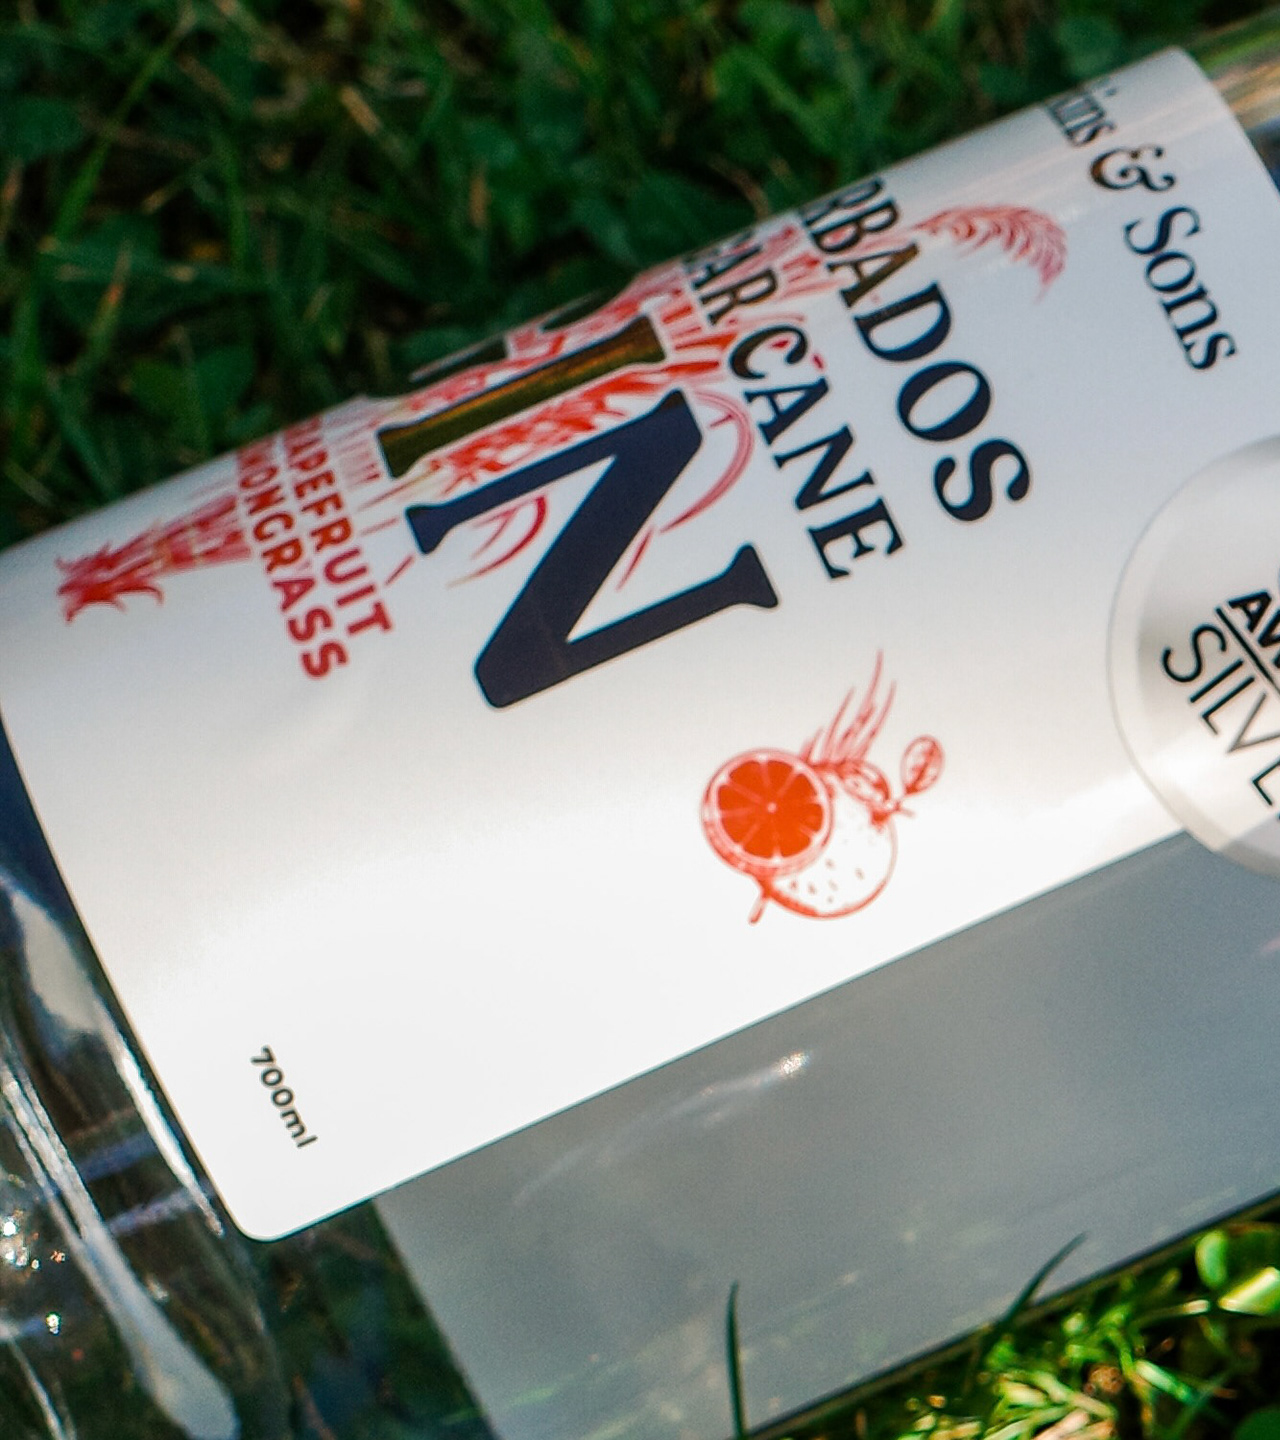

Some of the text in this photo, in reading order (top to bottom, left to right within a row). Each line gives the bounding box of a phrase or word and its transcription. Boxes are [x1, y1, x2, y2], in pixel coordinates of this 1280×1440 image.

[1091, 146, 1175, 191] &
[1124, 206, 1237, 370] Sons
[729, 325, 904, 580] CANE
[251, 1046, 318, 1149] 700ml
